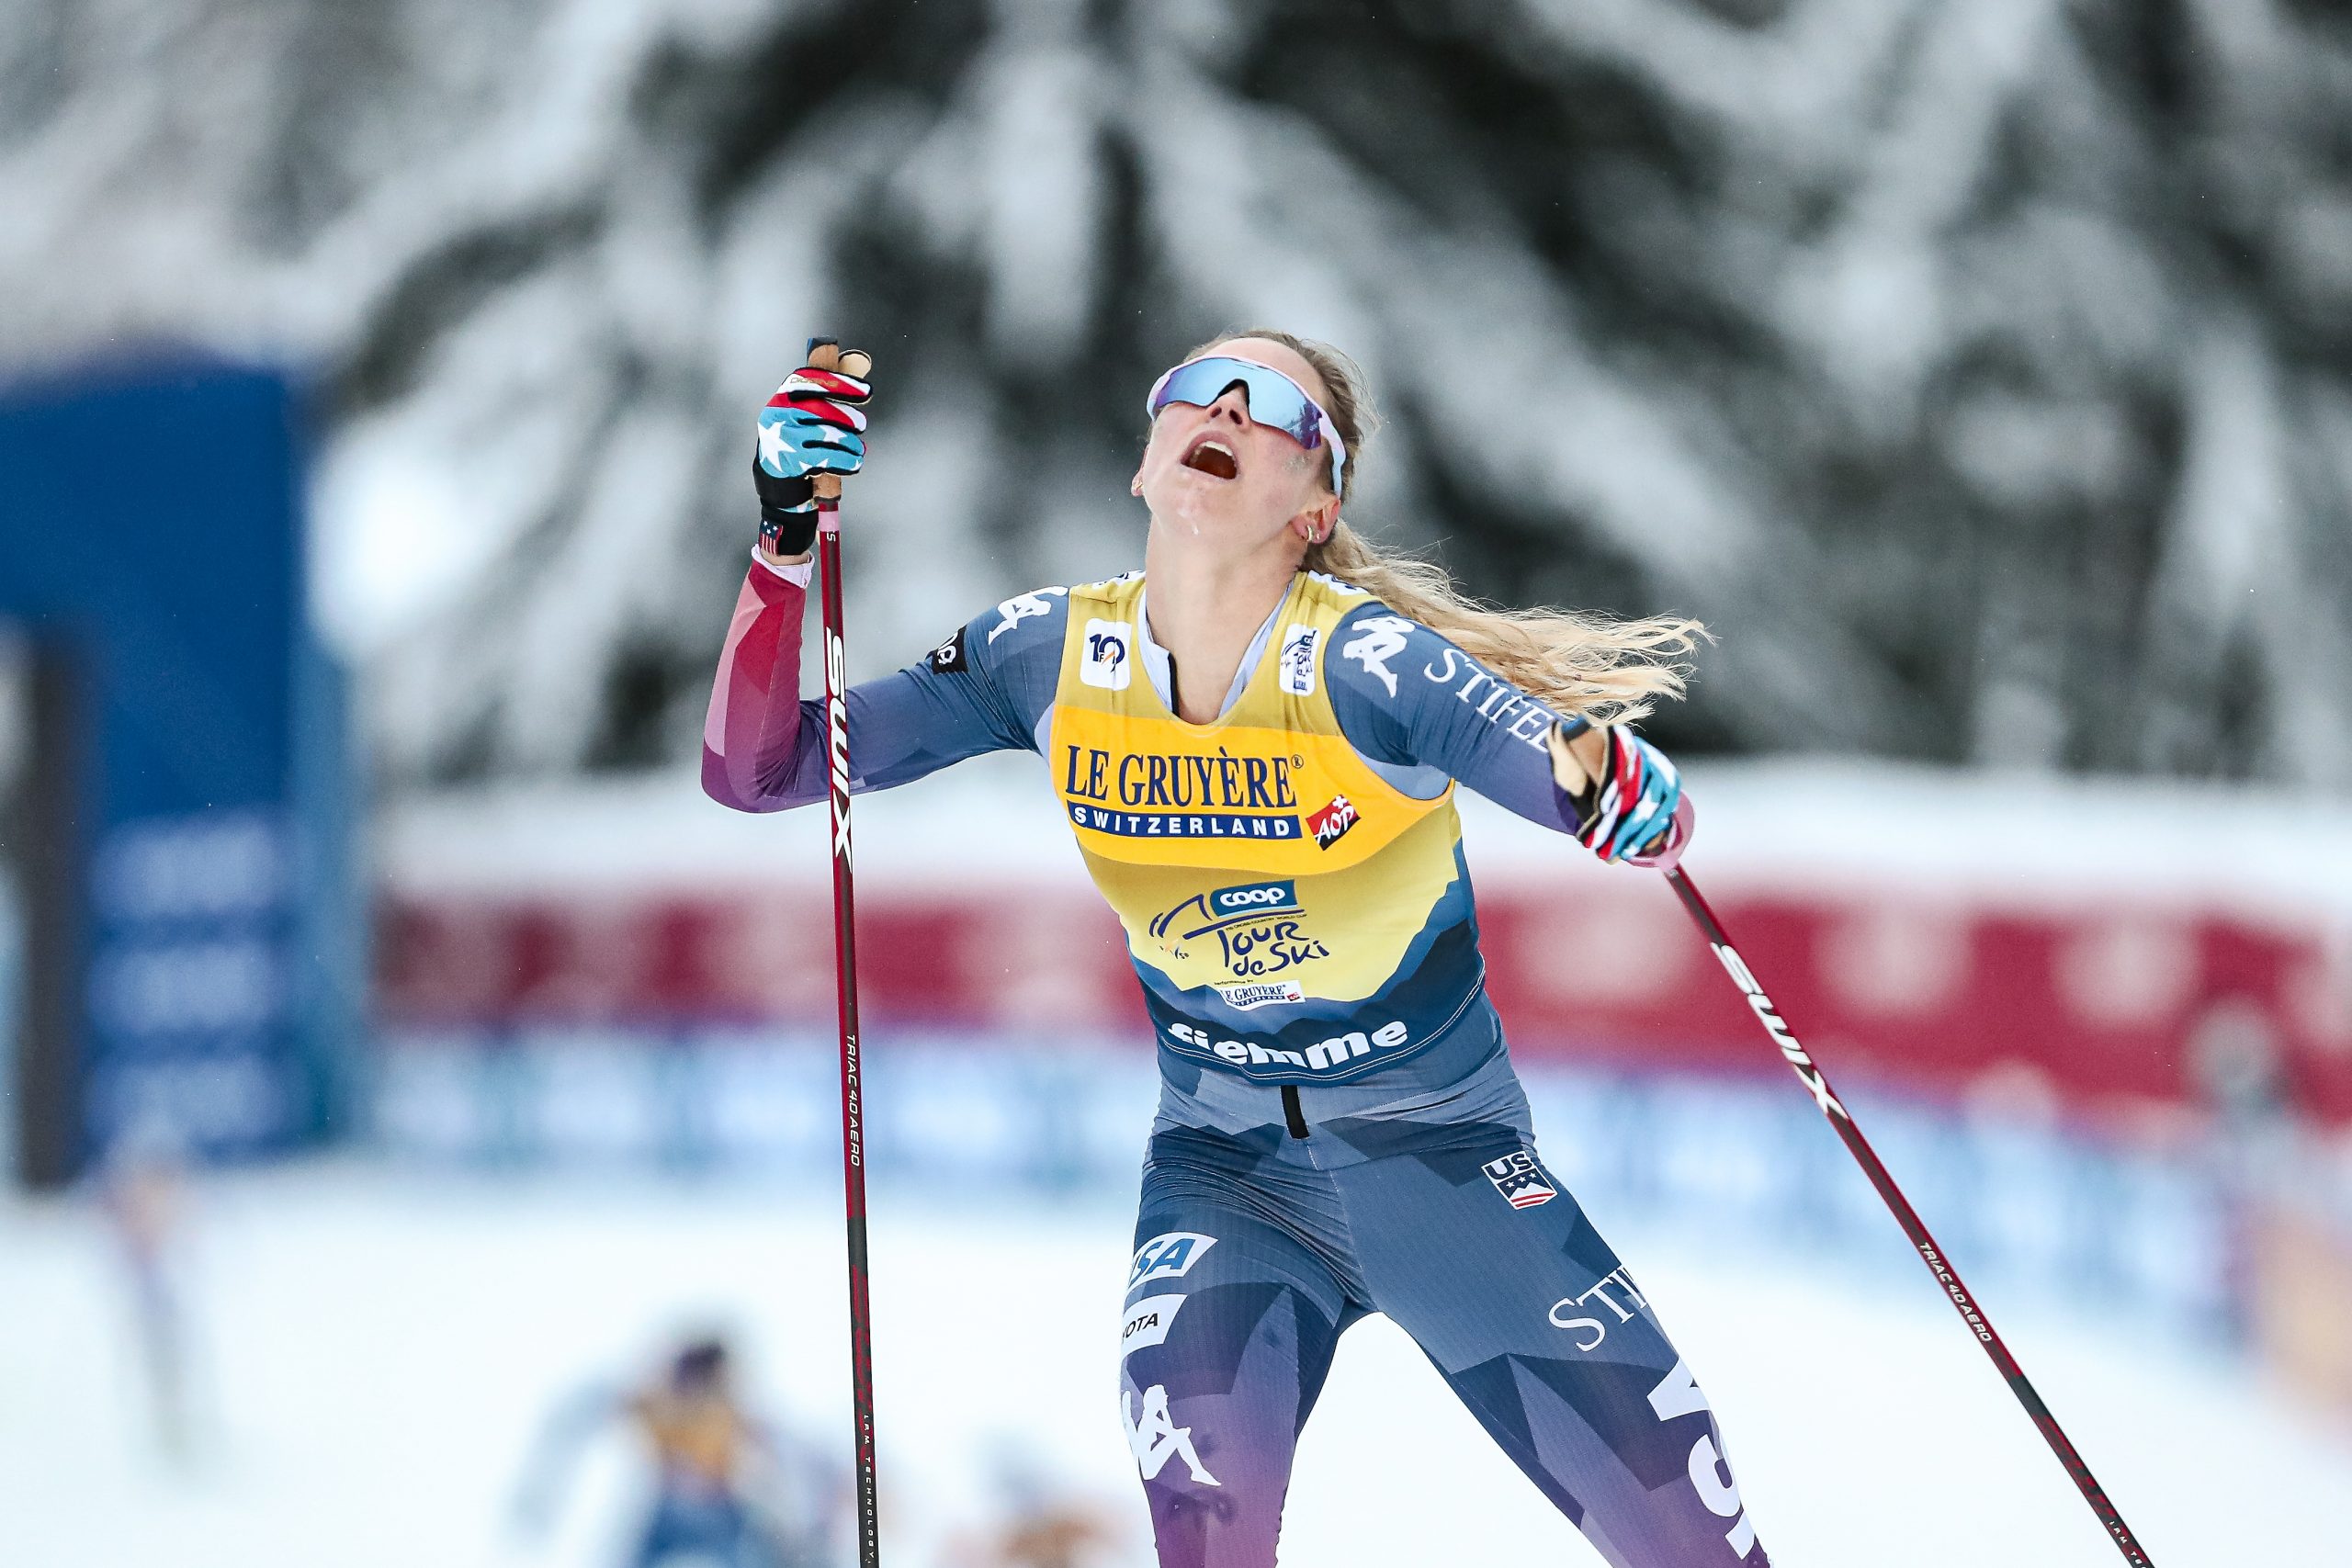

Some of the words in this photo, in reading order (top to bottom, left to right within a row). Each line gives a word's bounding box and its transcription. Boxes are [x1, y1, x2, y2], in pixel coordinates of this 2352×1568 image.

[826, 626, 854, 873] SWIX
[1066, 745, 1110, 801] LE
[1074, 807, 1291, 837] SWITZERLAND
[1314, 805, 1355, 845] AOP
[1219, 886, 1286, 908] coop
[1232, 955, 1267, 976] de
[1709, 942, 1850, 1120] SWIX
[846, 1034, 857, 1088] TRIAC
[849, 1115, 861, 1168] AERO
[1127, 1238, 1196, 1289] SA
[1548, 1264, 1648, 1352] STI
[1919, 1242, 1953, 1282] TRIAC
[1960, 1304, 1993, 1342] AERO
[1123, 1313, 1159, 1339] OTA
